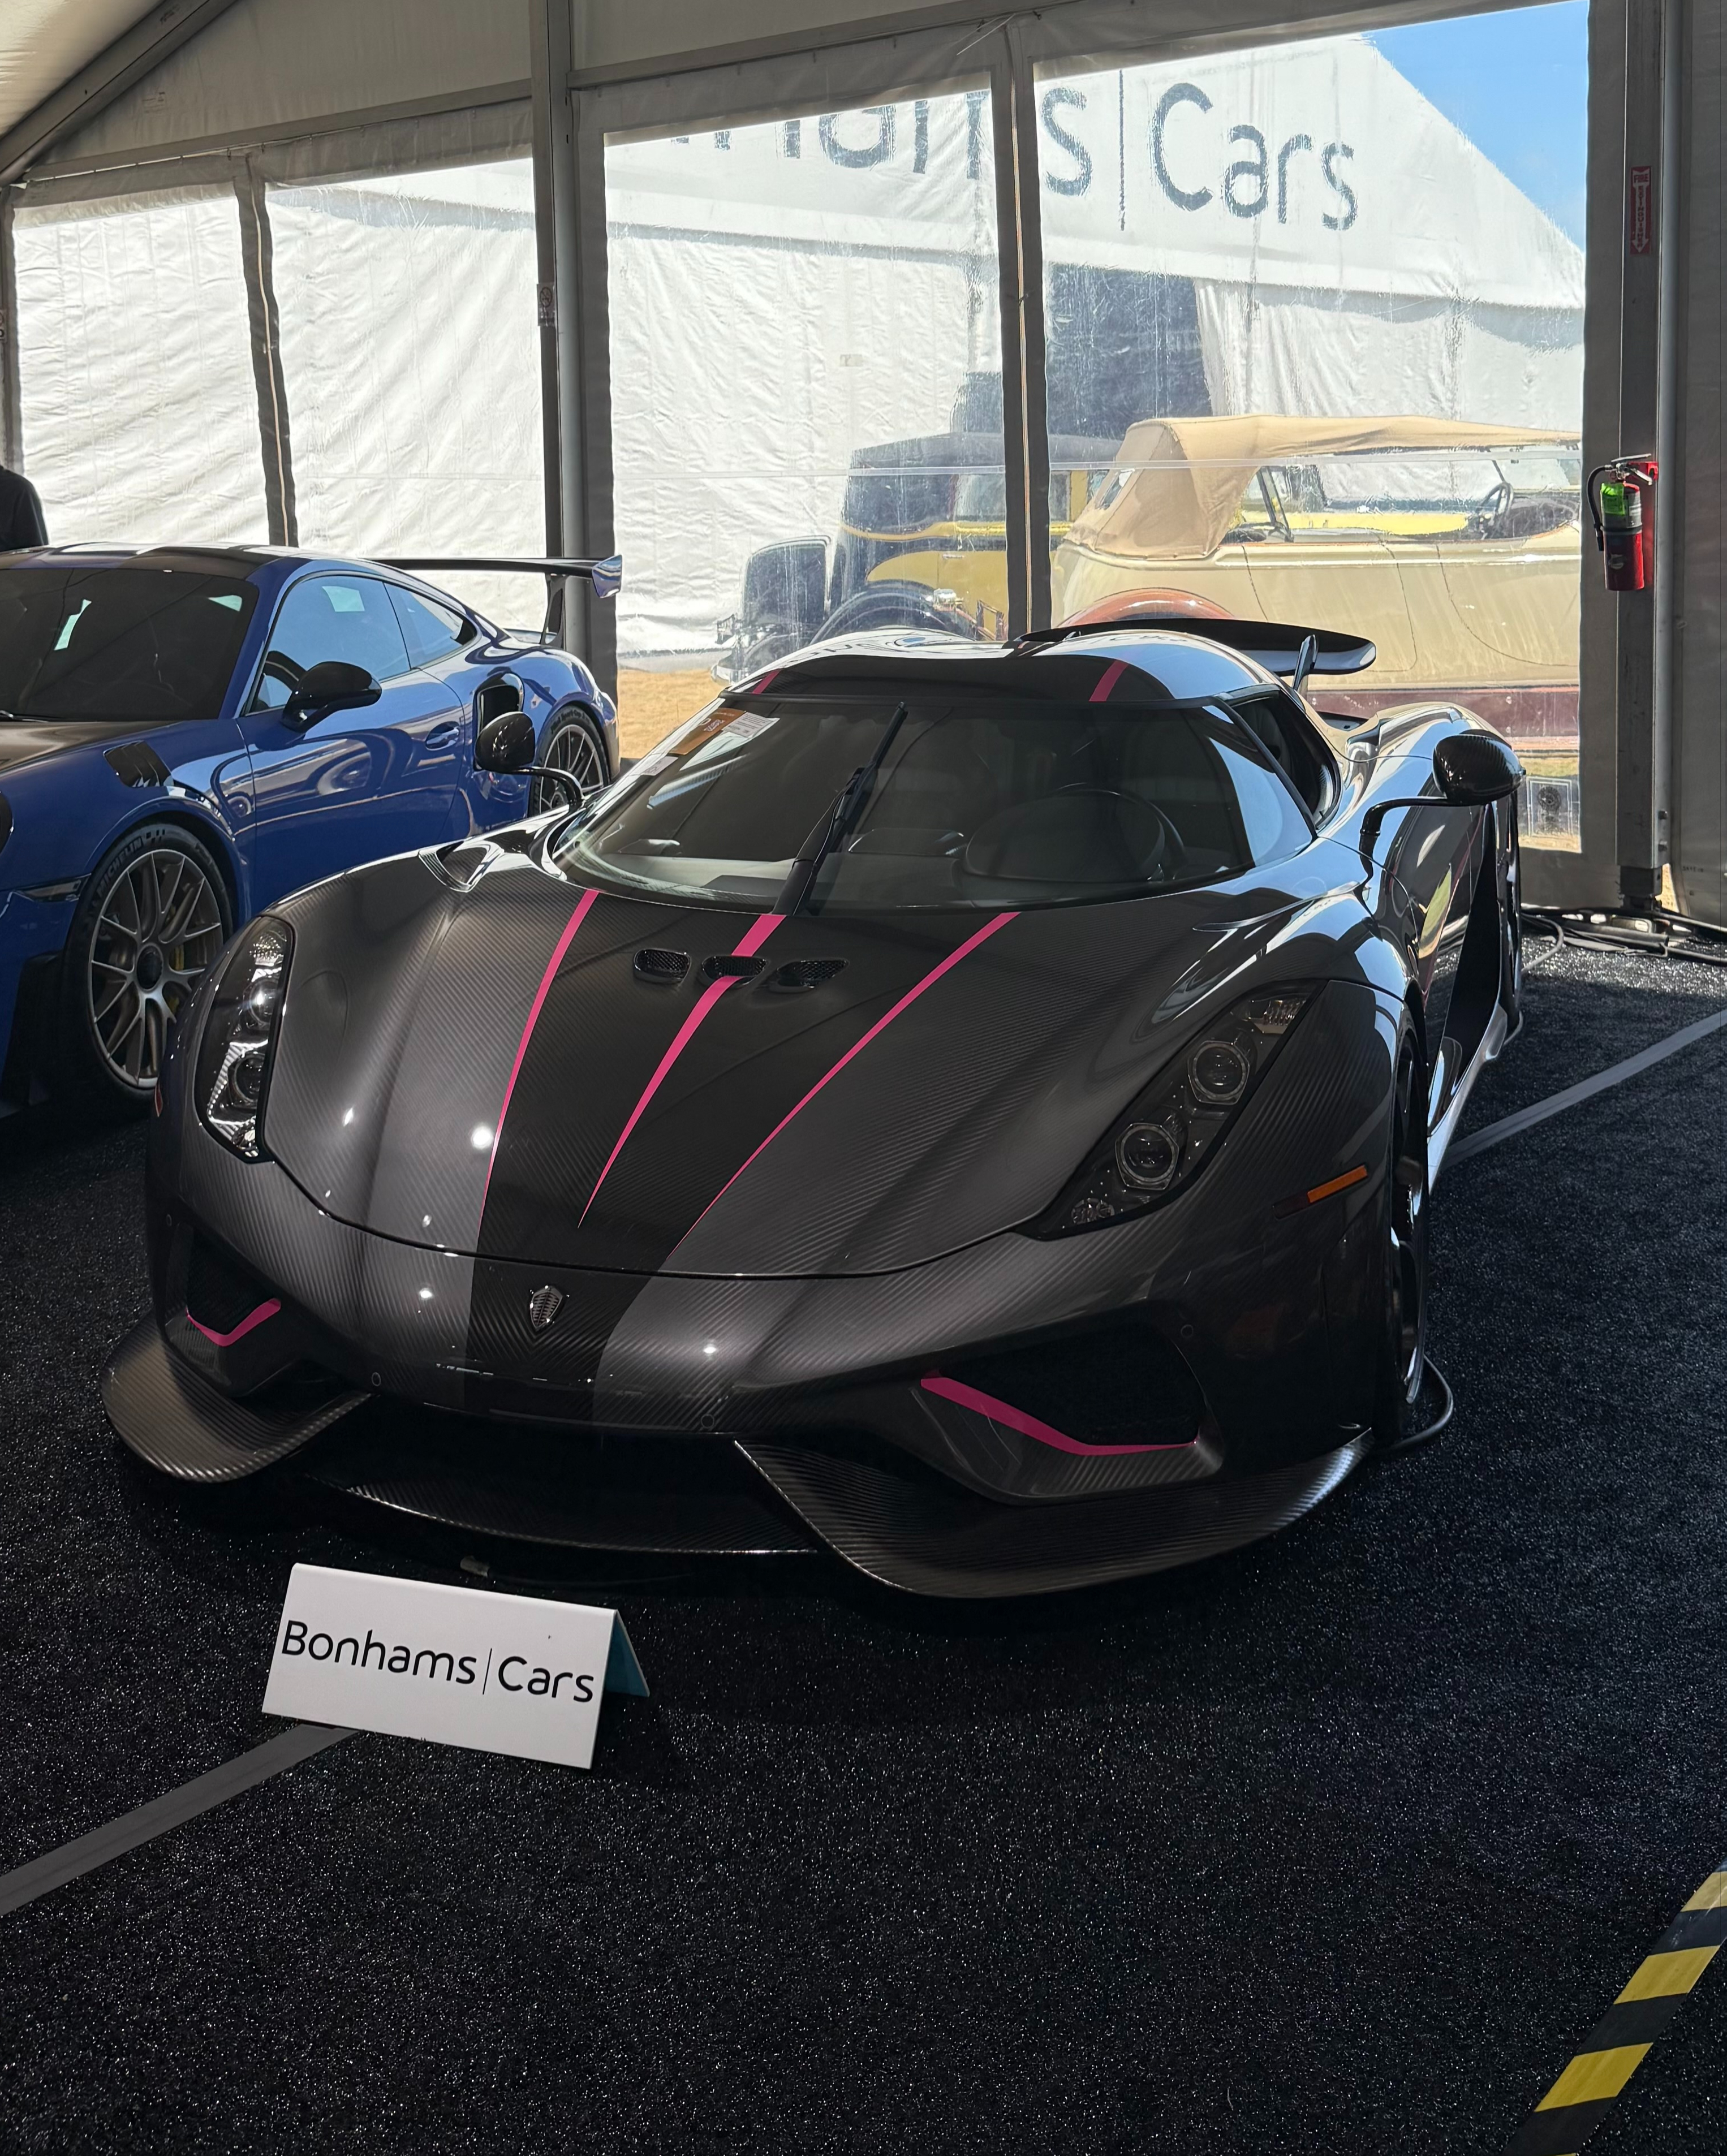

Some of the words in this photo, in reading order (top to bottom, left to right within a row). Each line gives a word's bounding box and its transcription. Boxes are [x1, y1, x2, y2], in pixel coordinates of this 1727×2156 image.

[1150, 83, 1358, 230] Cars
[1634, 174, 1649, 183] FIRE
[96, 836, 144, 898] MICHELIN
[282, 1620, 477, 1684] Bonhams
[498, 1656, 594, 1703] Cars
